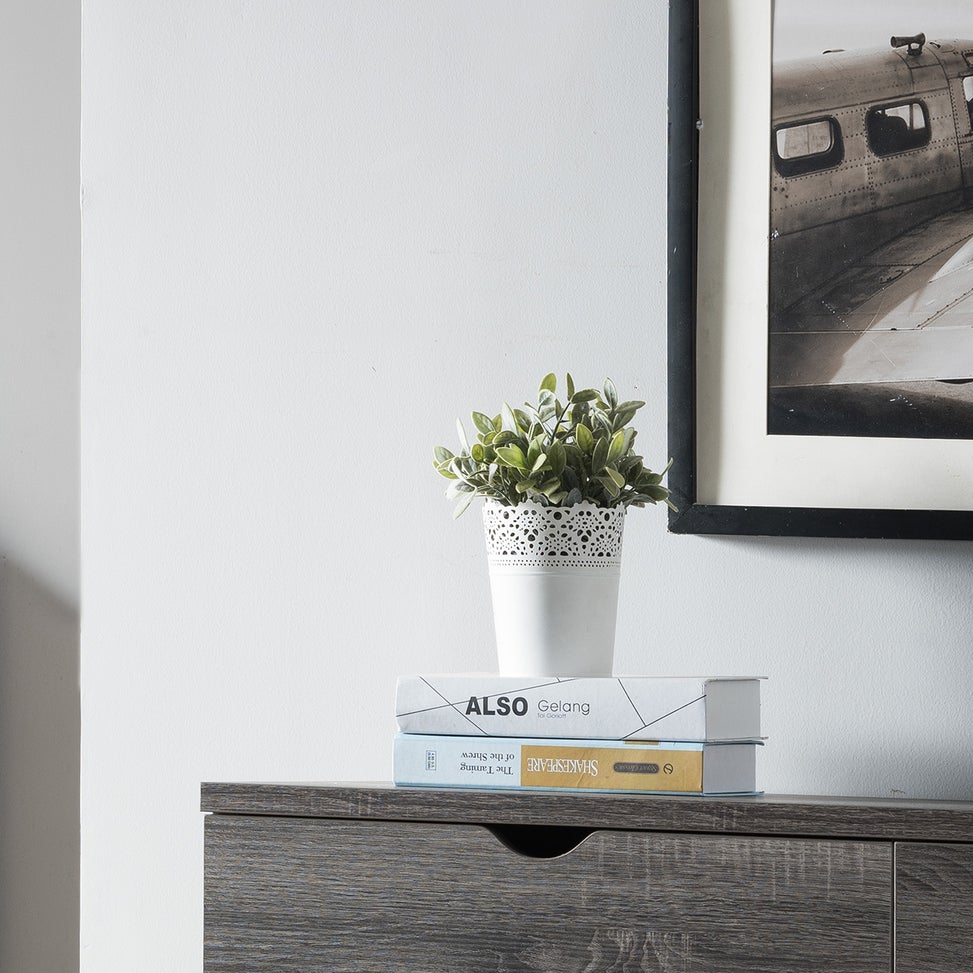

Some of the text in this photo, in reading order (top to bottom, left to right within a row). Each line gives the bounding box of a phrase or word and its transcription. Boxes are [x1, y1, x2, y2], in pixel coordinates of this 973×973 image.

[465, 696, 590, 717] ALSO Gelang
[461, 752, 515, 761] of the Shrew
[460, 762, 514, 775] The Taming
[527, 757, 599, 776] SHAKESPEARE
